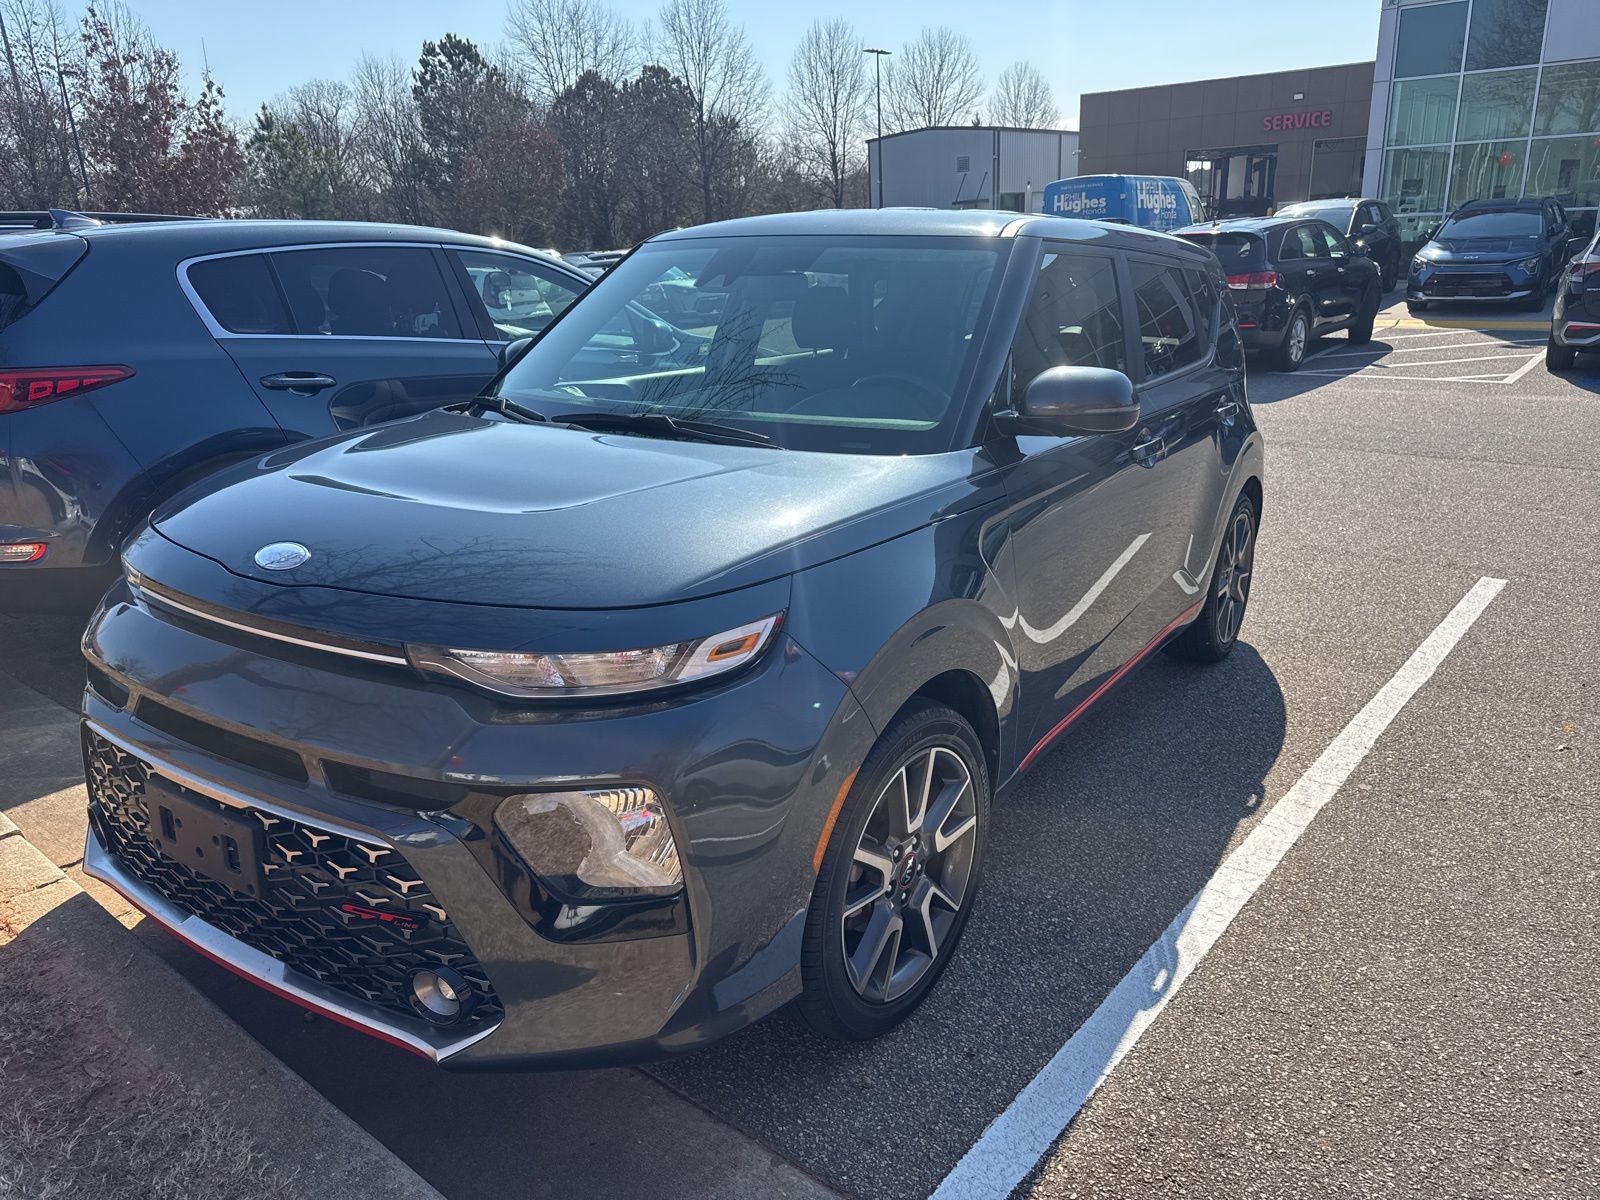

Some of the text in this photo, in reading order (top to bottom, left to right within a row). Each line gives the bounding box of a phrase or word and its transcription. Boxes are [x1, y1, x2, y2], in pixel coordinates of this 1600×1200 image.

[1263, 111, 1331, 131] SERVICE
[1054, 192, 1106, 213] Hughes
[1137, 181, 1176, 214] Hughes
[1082, 207, 1106, 216] Honda
[1160, 209, 1176, 219] Honda
